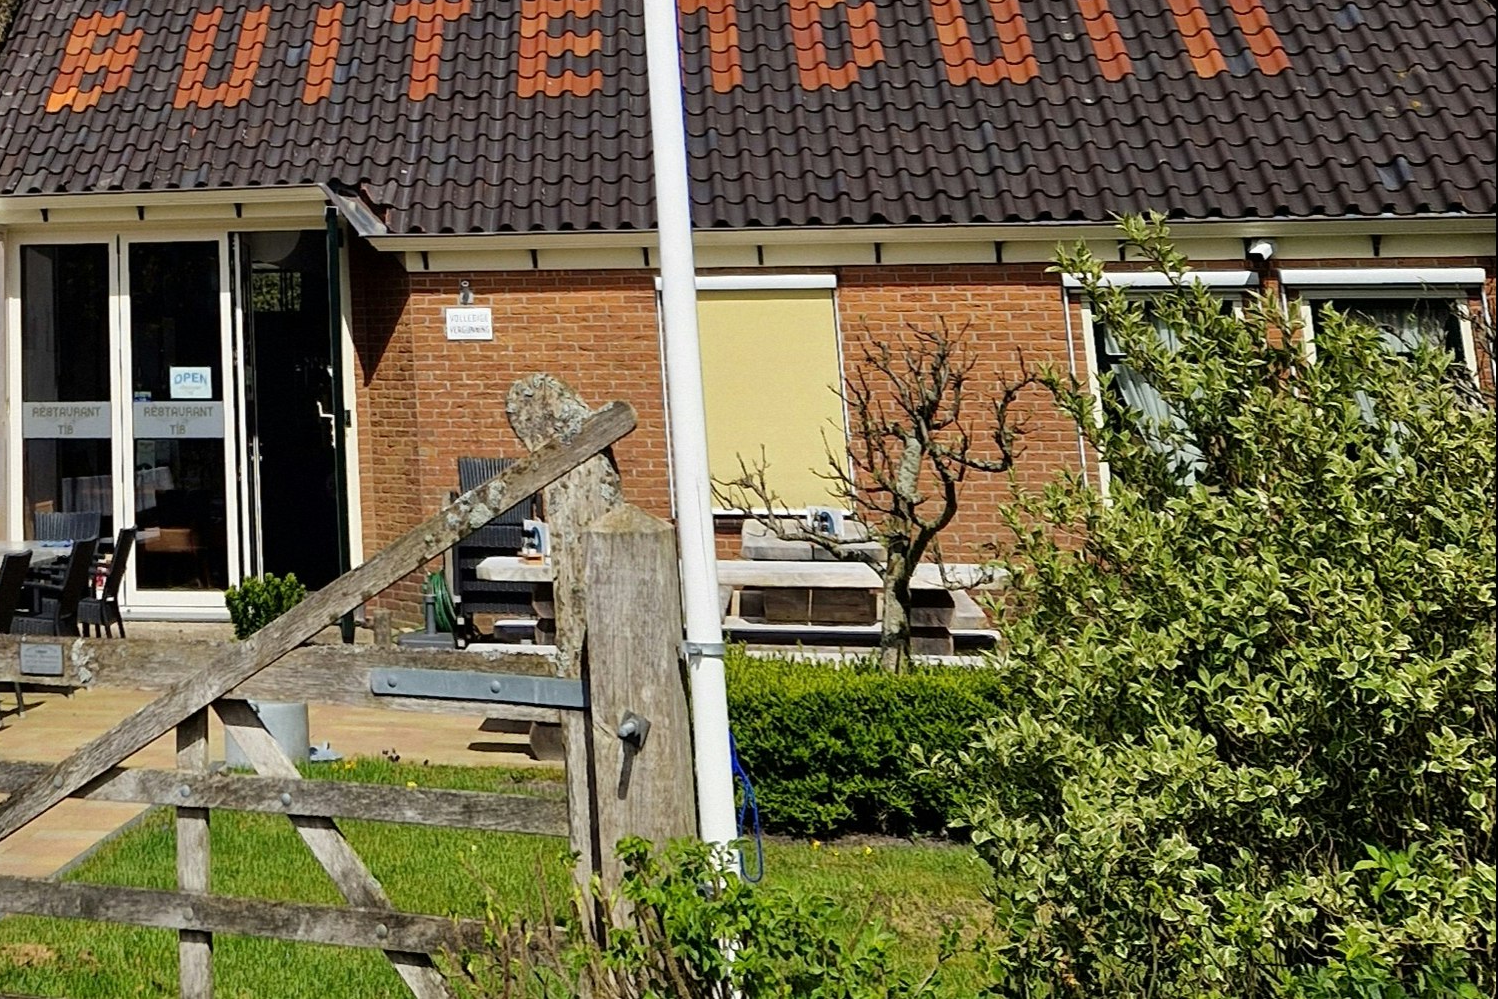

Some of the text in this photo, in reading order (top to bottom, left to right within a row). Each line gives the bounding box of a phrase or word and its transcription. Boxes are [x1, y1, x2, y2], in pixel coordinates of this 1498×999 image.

[174, 372, 208, 386] OPEN
[32, 406, 101, 418] RESTAURANT
[143, 406, 214, 418] RESTAURANT
